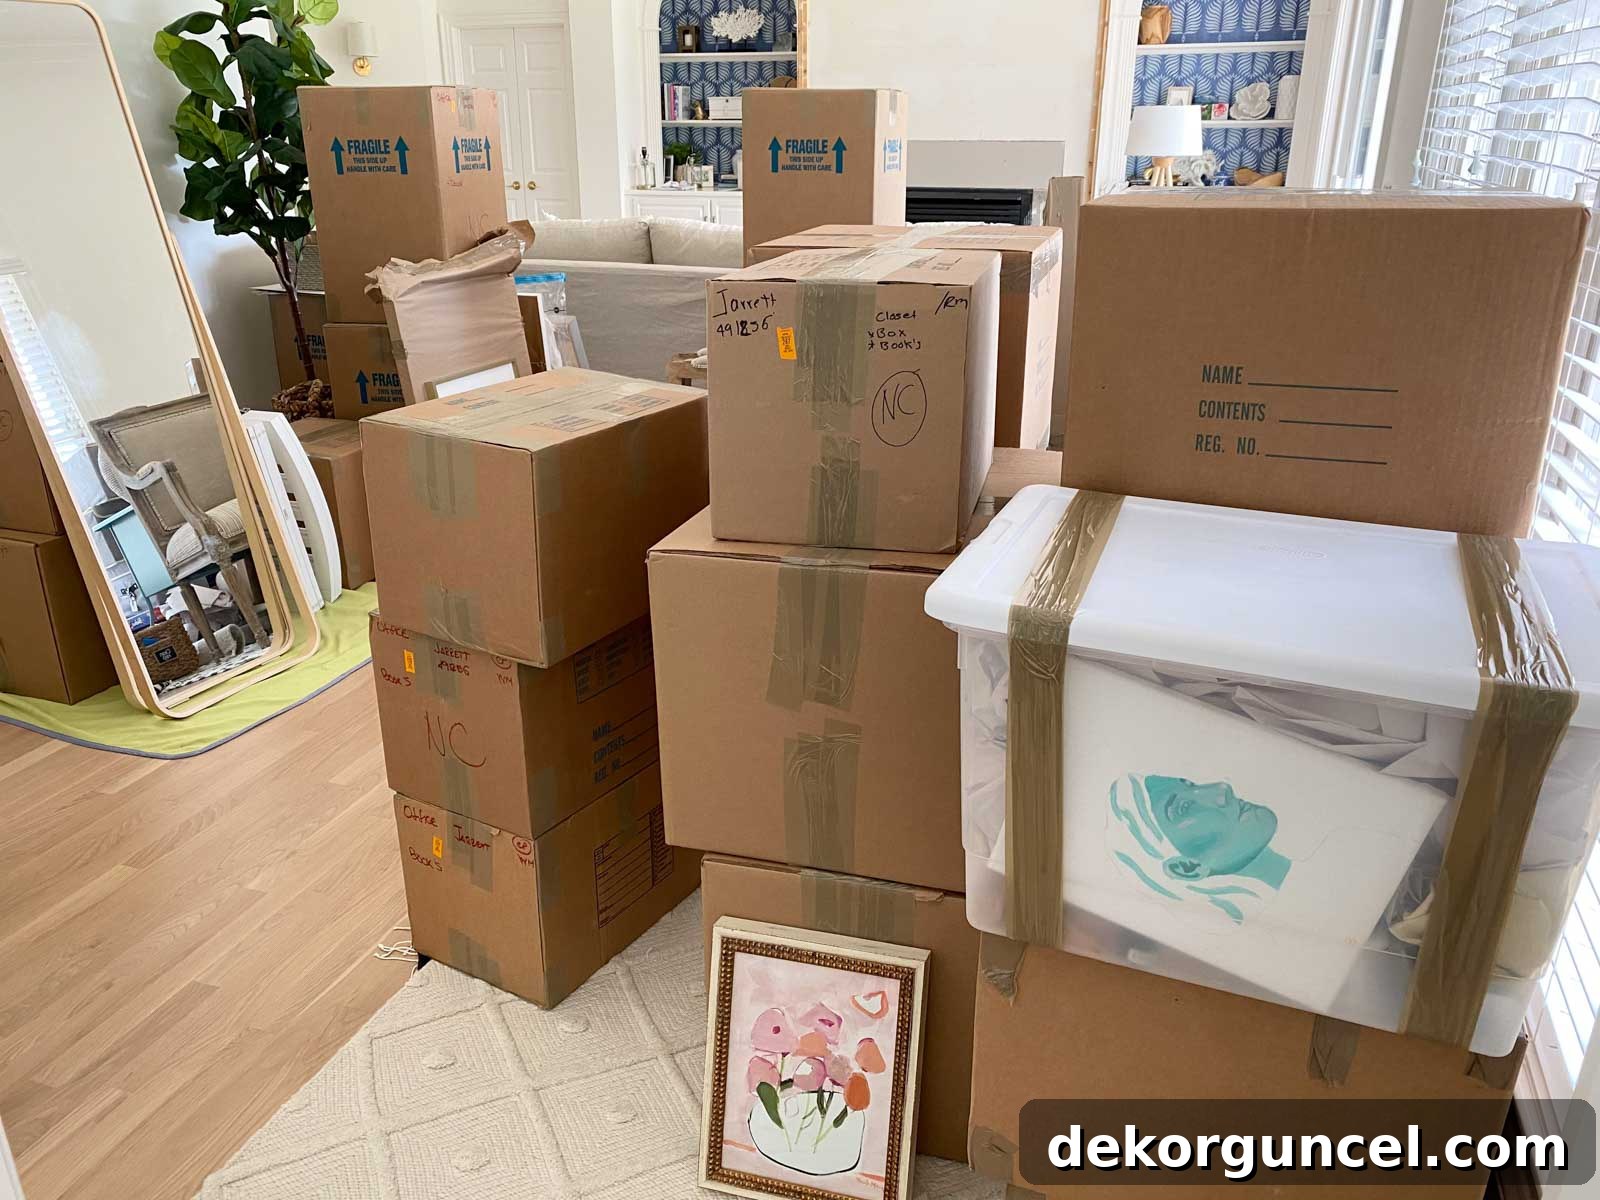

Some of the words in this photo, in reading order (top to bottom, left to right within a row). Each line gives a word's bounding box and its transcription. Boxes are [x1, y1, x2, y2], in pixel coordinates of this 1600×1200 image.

[346, 139, 391, 155] FRAGILE
[461, 137, 483, 153] FRAGILE
[785, 139, 829, 155] FRAGILE
[353, 156, 366, 164] THIS
[367, 165, 382, 173] WITH
[382, 165, 397, 173] CARE
[712, 288, 777, 318] Jarrett
[875, 310, 917, 322] Closet
[371, 372, 400, 387] FRAG
[1201, 365, 1244, 385] NAME
[881, 383, 916, 425] NC
[1198, 400, 1266, 422] CONTENTS
[1194, 434, 1226, 453] REG.
[1236, 436, 1260, 456] NO.
[424, 710, 487, 768] NC
